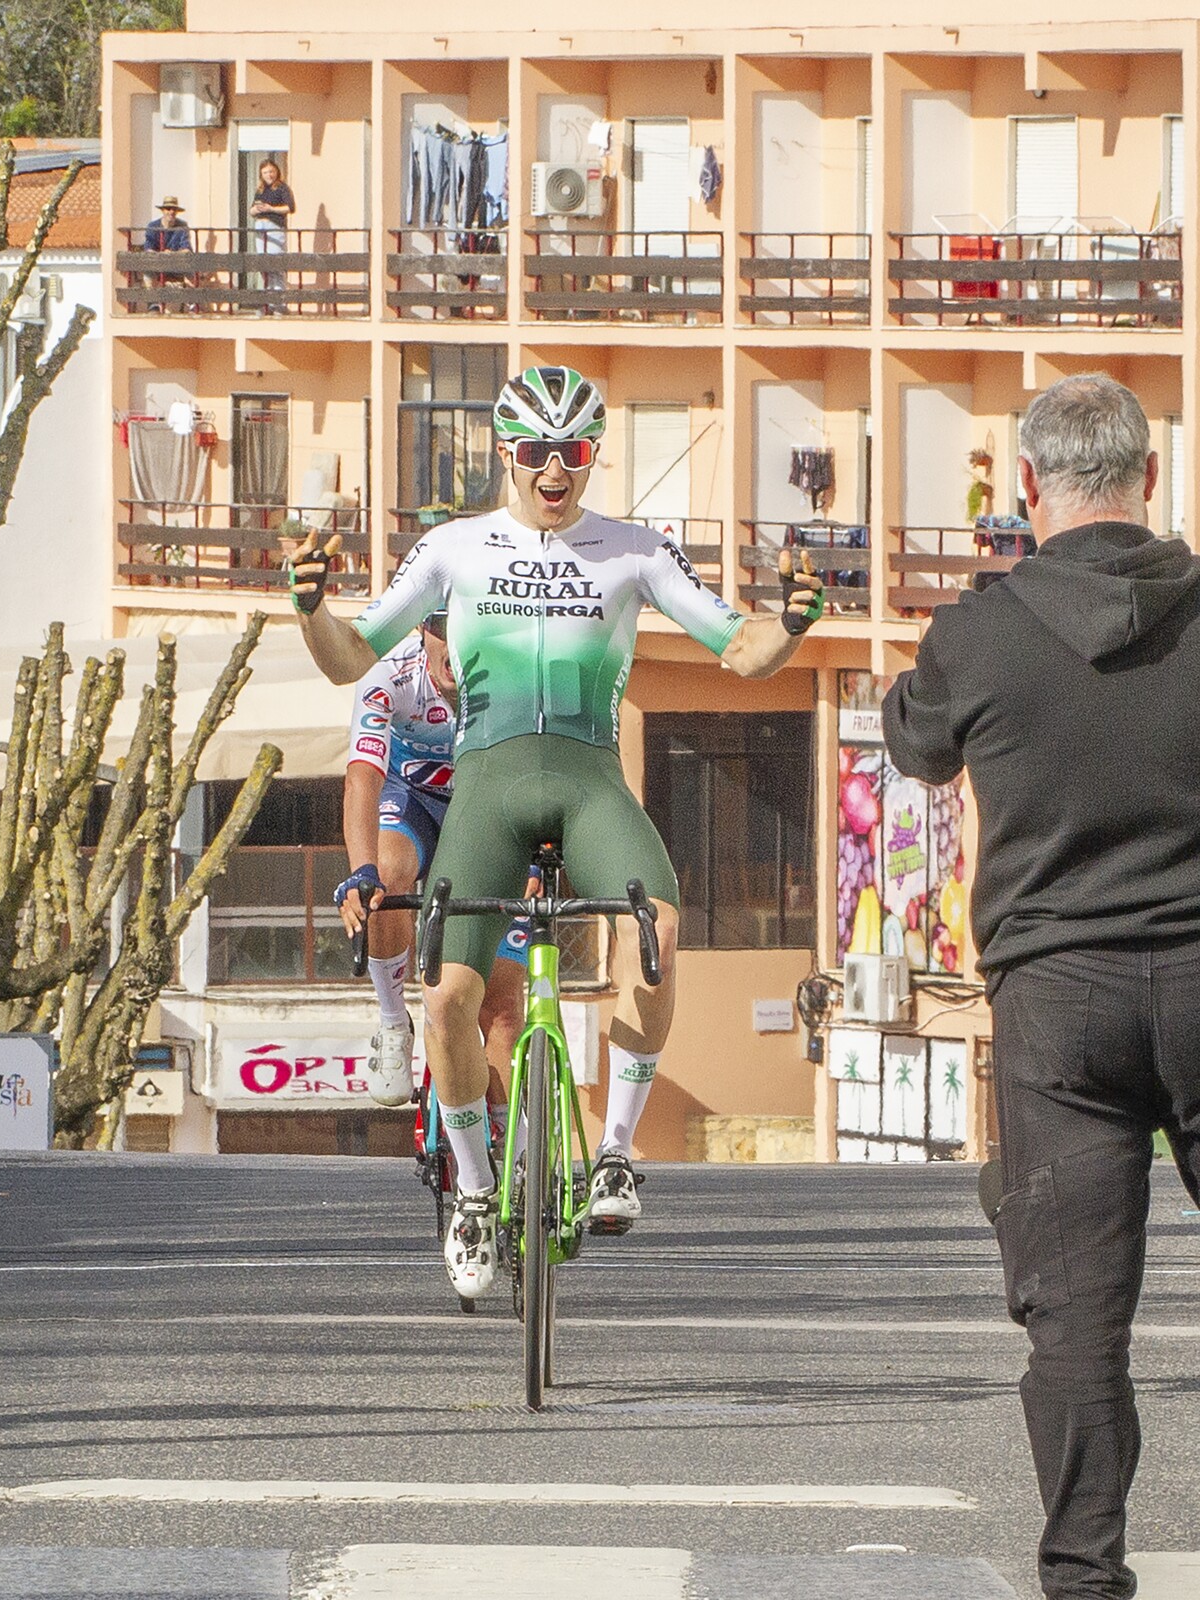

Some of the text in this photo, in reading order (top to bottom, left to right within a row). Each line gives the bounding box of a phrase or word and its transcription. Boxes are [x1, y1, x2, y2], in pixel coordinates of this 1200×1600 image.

[508, 560, 585, 581] CAJA
[661, 541, 702, 590] RGA
[487, 577, 603, 600] RURAL
[477, 602, 604, 621] SEGUROS RGA
